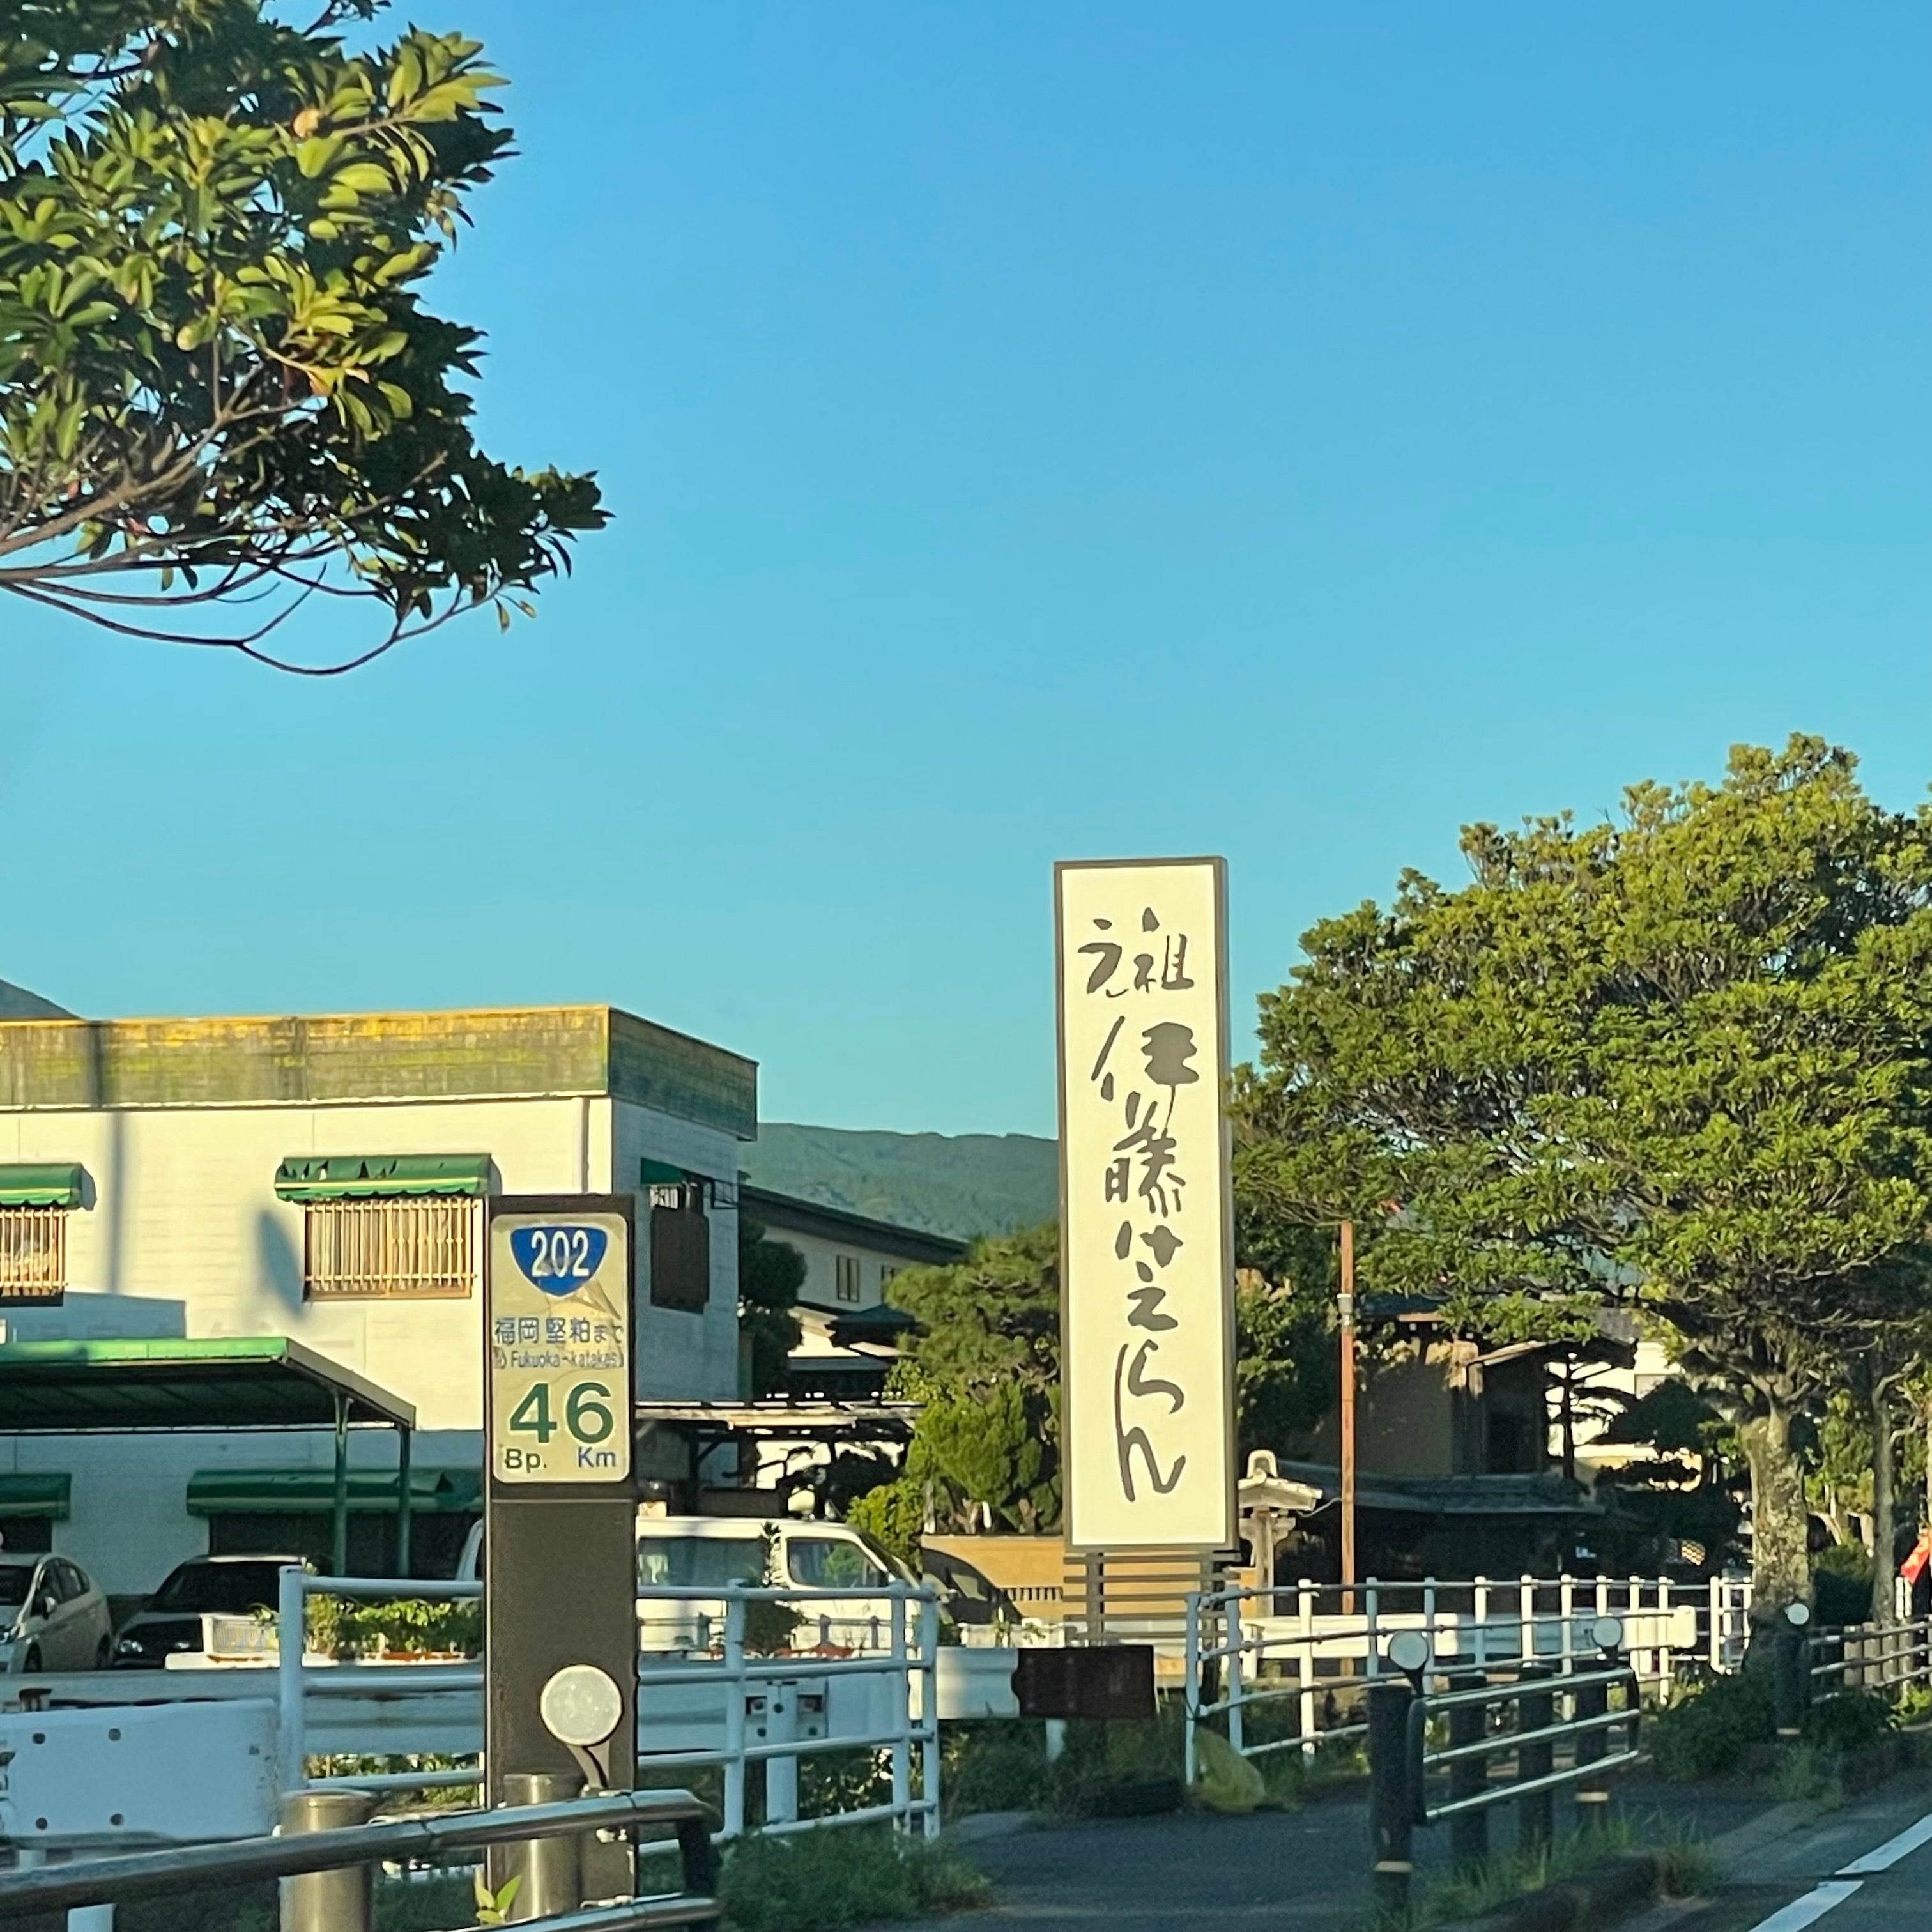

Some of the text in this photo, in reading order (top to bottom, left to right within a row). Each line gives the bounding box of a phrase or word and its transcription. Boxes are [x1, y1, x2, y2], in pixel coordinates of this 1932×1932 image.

[530, 1229, 590, 1278] 202
[495, 1317, 539, 1345] 福岡
[510, 1382, 613, 1443] 46
[578, 1446, 616, 1468] Km
